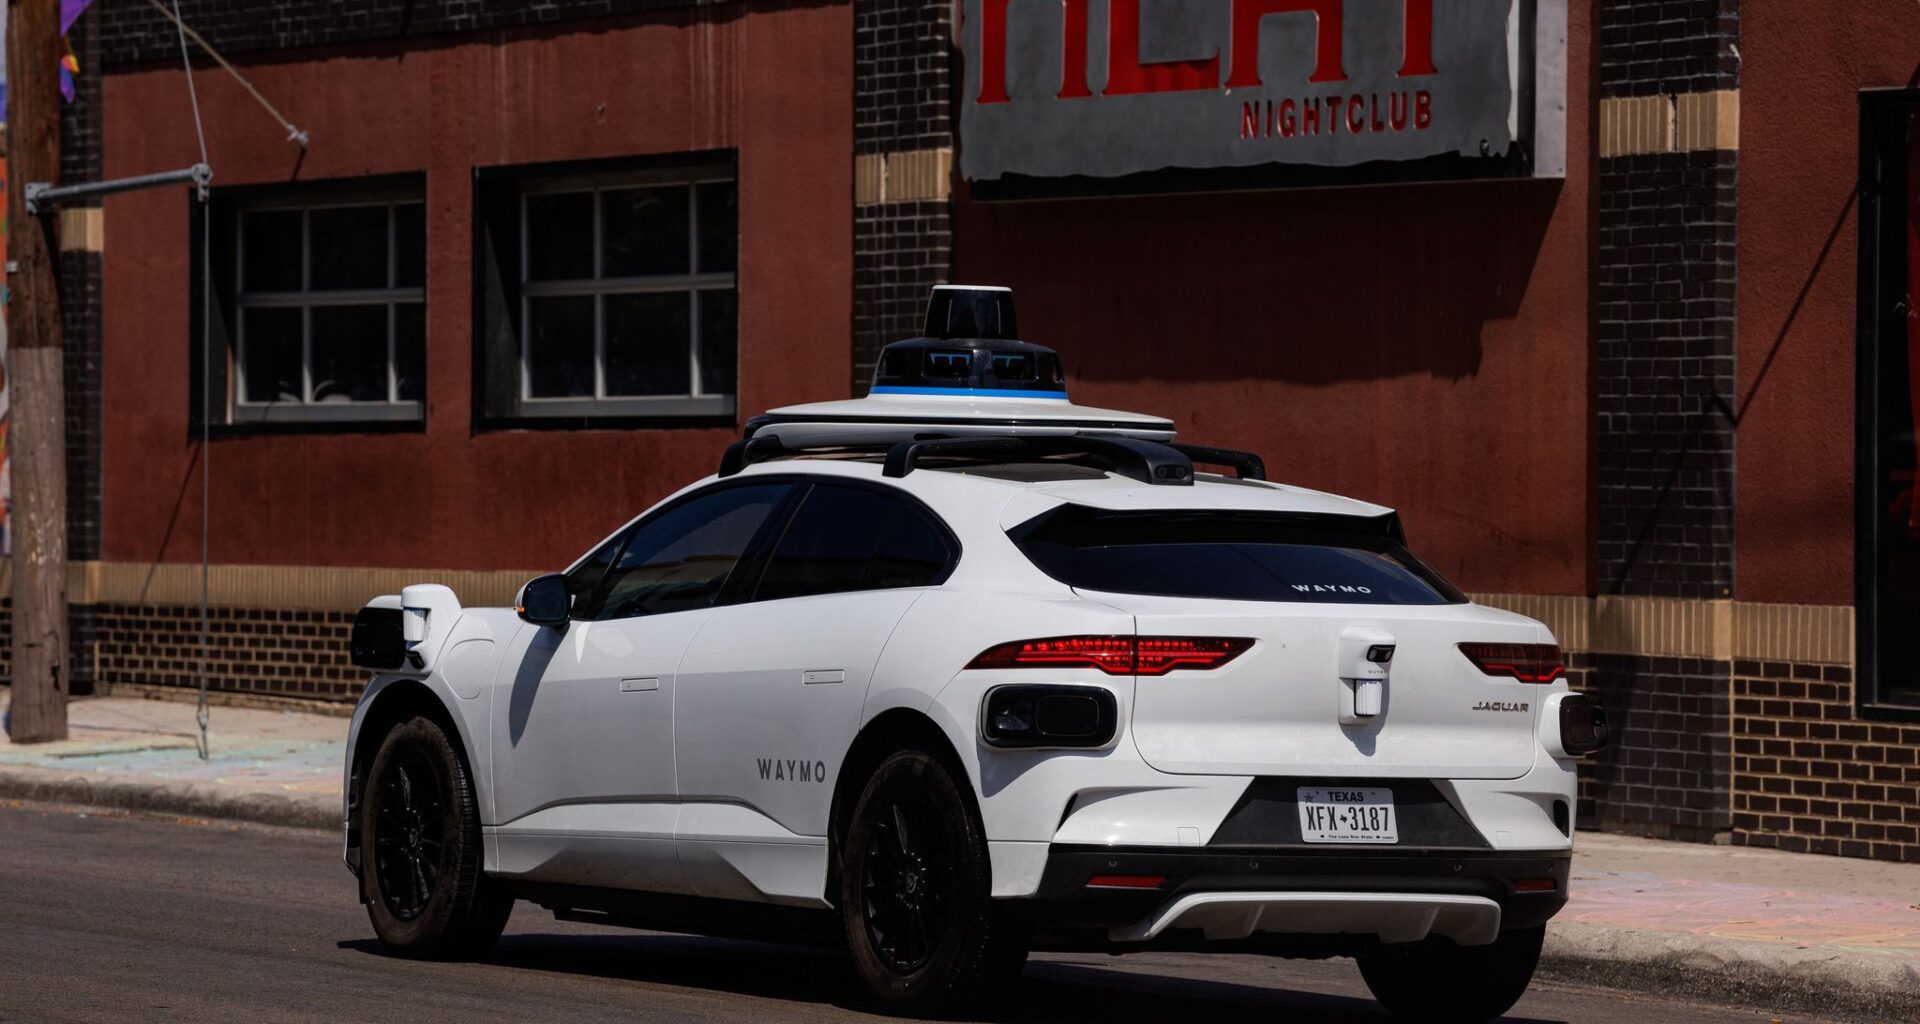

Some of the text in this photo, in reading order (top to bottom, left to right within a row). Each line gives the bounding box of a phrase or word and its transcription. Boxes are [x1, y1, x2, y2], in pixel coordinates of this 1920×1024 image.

[1241, 91, 1432, 140] NIGHTCLUB
[1291, 585, 1371, 594] WAYMO
[1472, 701, 1529, 712] JAGUAR
[757, 758, 826, 783] WAYMO
[1328, 791, 1364, 802] TEXAS
